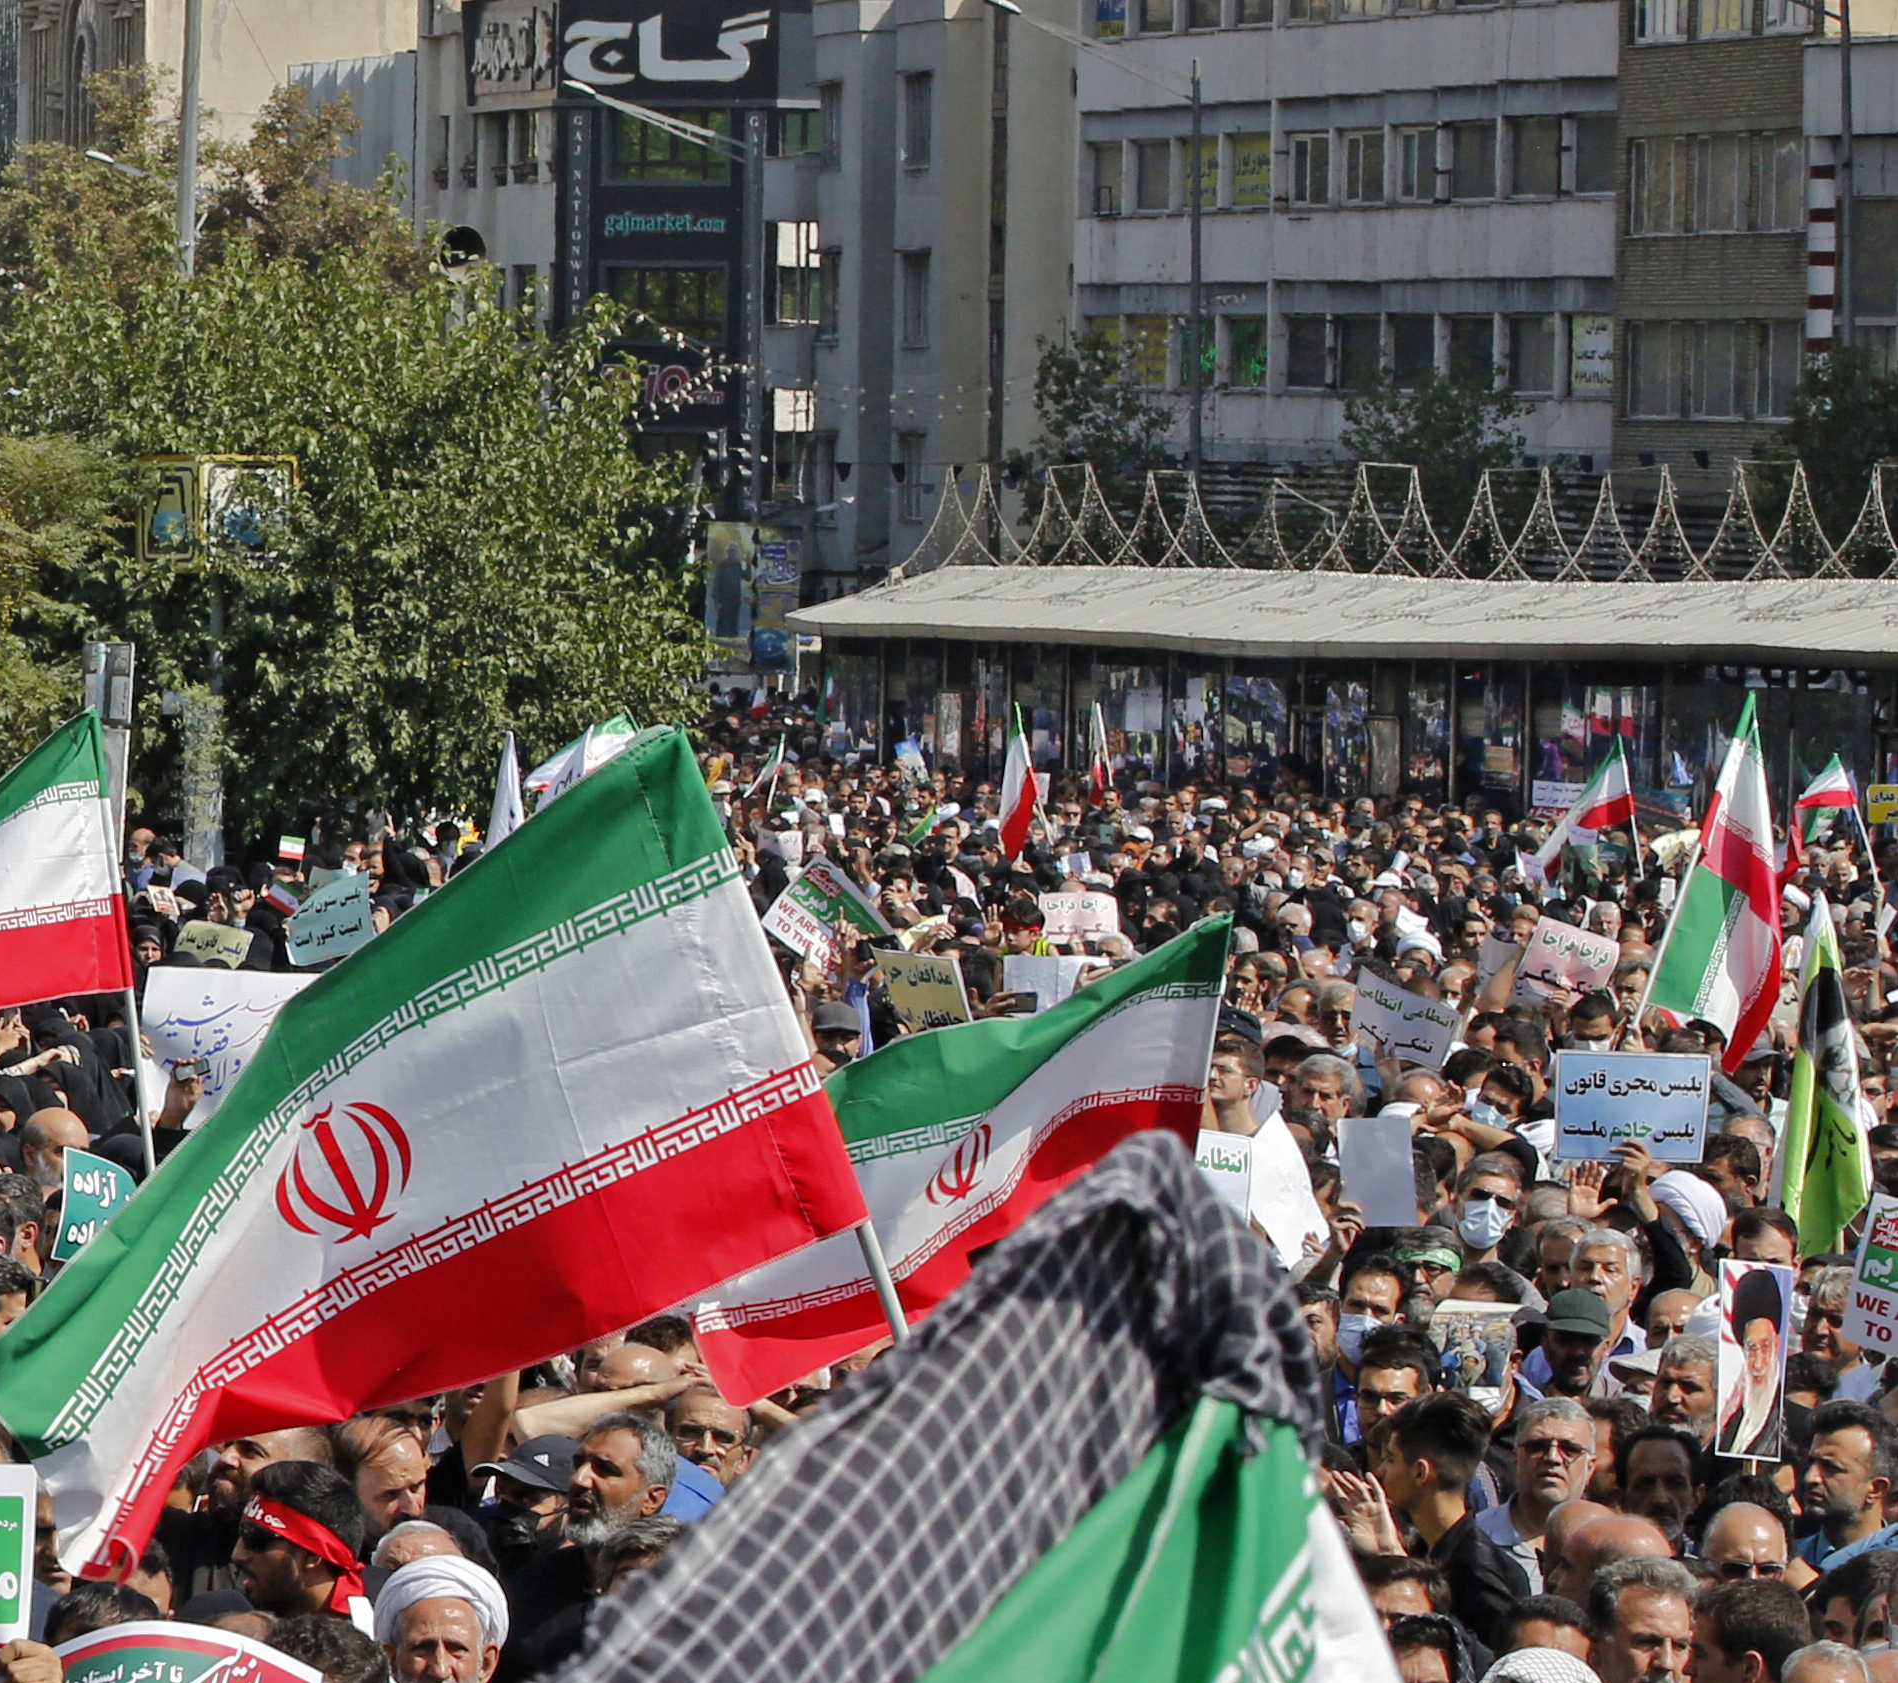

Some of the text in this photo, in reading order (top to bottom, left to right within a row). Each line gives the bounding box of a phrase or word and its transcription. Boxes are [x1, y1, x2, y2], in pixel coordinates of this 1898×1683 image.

[562, 10, 771, 85] گاج
[572, 115, 584, 157] GAJ
[604, 211, 726, 236] gajmarket.com
[339, 887, 362, 908] پلیس
[778, 899, 819, 936] WE ARE
[294, 919, 363, 947] امنیت کشور است
[775, 917, 793, 935] TO
[792, 931, 815, 952] THE
[216, 941, 243, 960] پلیس
[1358, 987, 1454, 1030] انتظامی انتظامی
[1565, 1069, 1703, 1099] پلیس مجری قانون
[1609, 1121, 1653, 1143] خادم
[1653, 1122, 1695, 1144] پلیس
[73, 1168, 117, 1208] آزاده
[1855, 1291, 1891, 1317] WE
[1864, 1320, 1893, 1342] TO
[169, 1665, 184, 1683] تا
